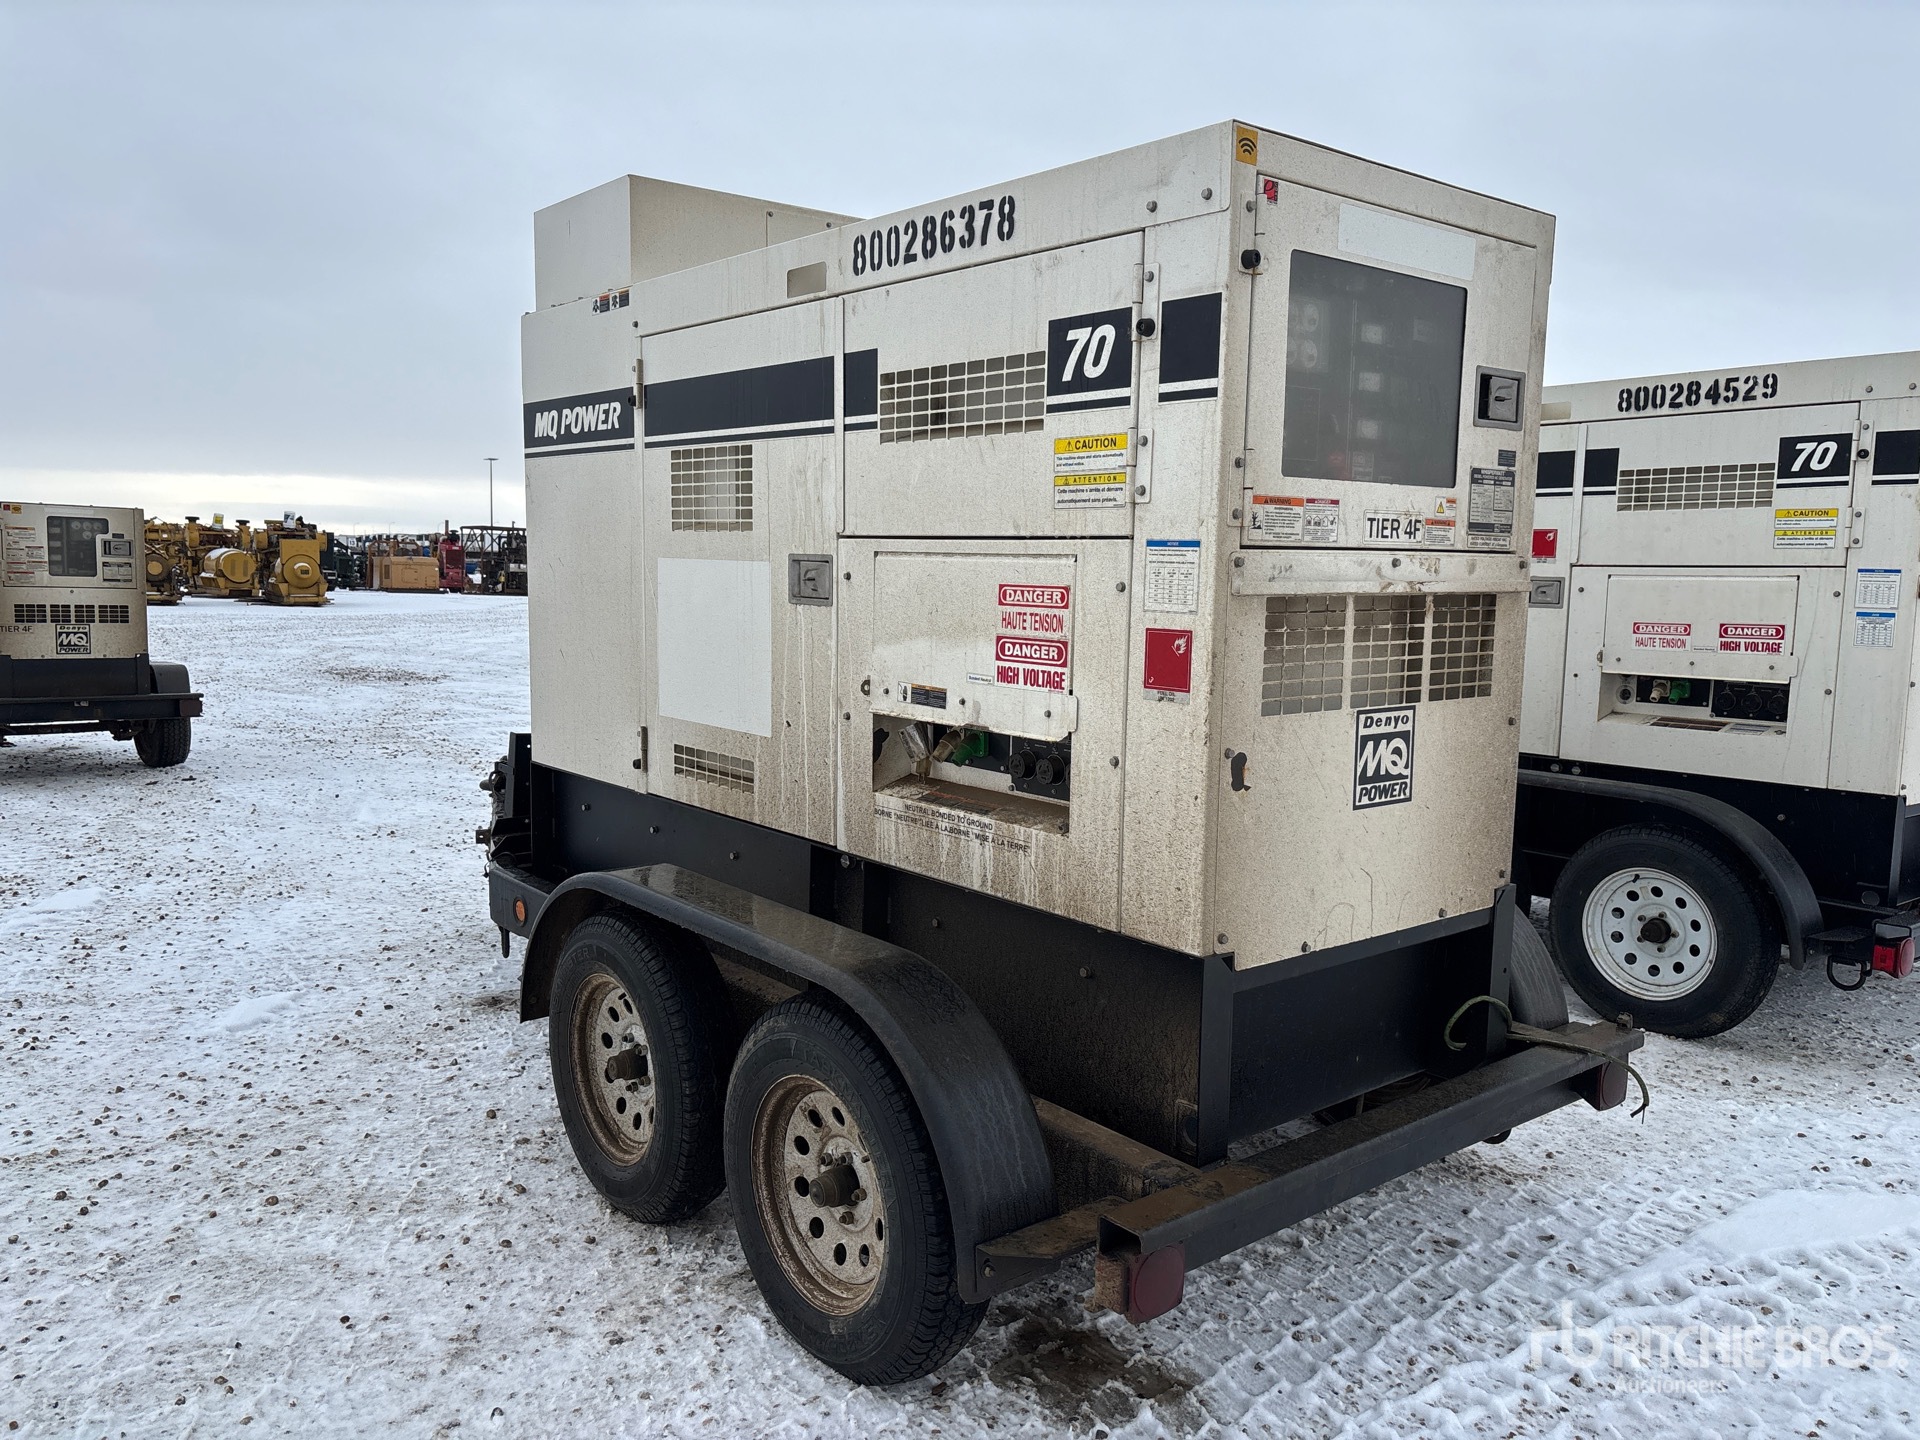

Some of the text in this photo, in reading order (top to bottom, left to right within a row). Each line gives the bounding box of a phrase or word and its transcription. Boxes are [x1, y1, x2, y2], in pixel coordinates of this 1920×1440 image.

[852, 195, 1016, 276] 800286378
[1062, 324, 1116, 382] 70
[1617, 373, 1779, 413] 800284529
[534, 401, 621, 440] MQ POWER
[1074, 437, 1117, 450] CAUTION
[1790, 441, 1838, 472] 70
[1073, 475, 1117, 483] ATTENTION
[1367, 517, 1401, 539] TIER
[1404, 518, 1422, 540] 4F
[1006, 589, 1062, 604] DANGER
[0, 625, 33, 633] TIER 4F
[1001, 611, 1064, 633] HAUTE TENSION
[1639, 625, 1685, 634] DANGER
[1727, 628, 1777, 636] DANGER
[59, 633, 88, 647] MQ
[1635, 637, 1687, 649] HAUTE TENSION
[1719, 640, 1783, 653] HIGH VOLTAGE
[1004, 643, 1058, 660] DANGER
[996, 665, 1066, 691] HIGH VOLTAGE
[1362, 714, 1410, 730] Denyo
[1358, 737, 1409, 778] MQ
[1358, 781, 1408, 804] POWER
[874, 808, 893, 819] BORNE
[940, 825, 949, 833] LA
[950, 827, 971, 839] BORNE
[996, 838, 1006, 846] LA
[904, 803, 993, 831] NEUTRAL BONDED TO GROUND
